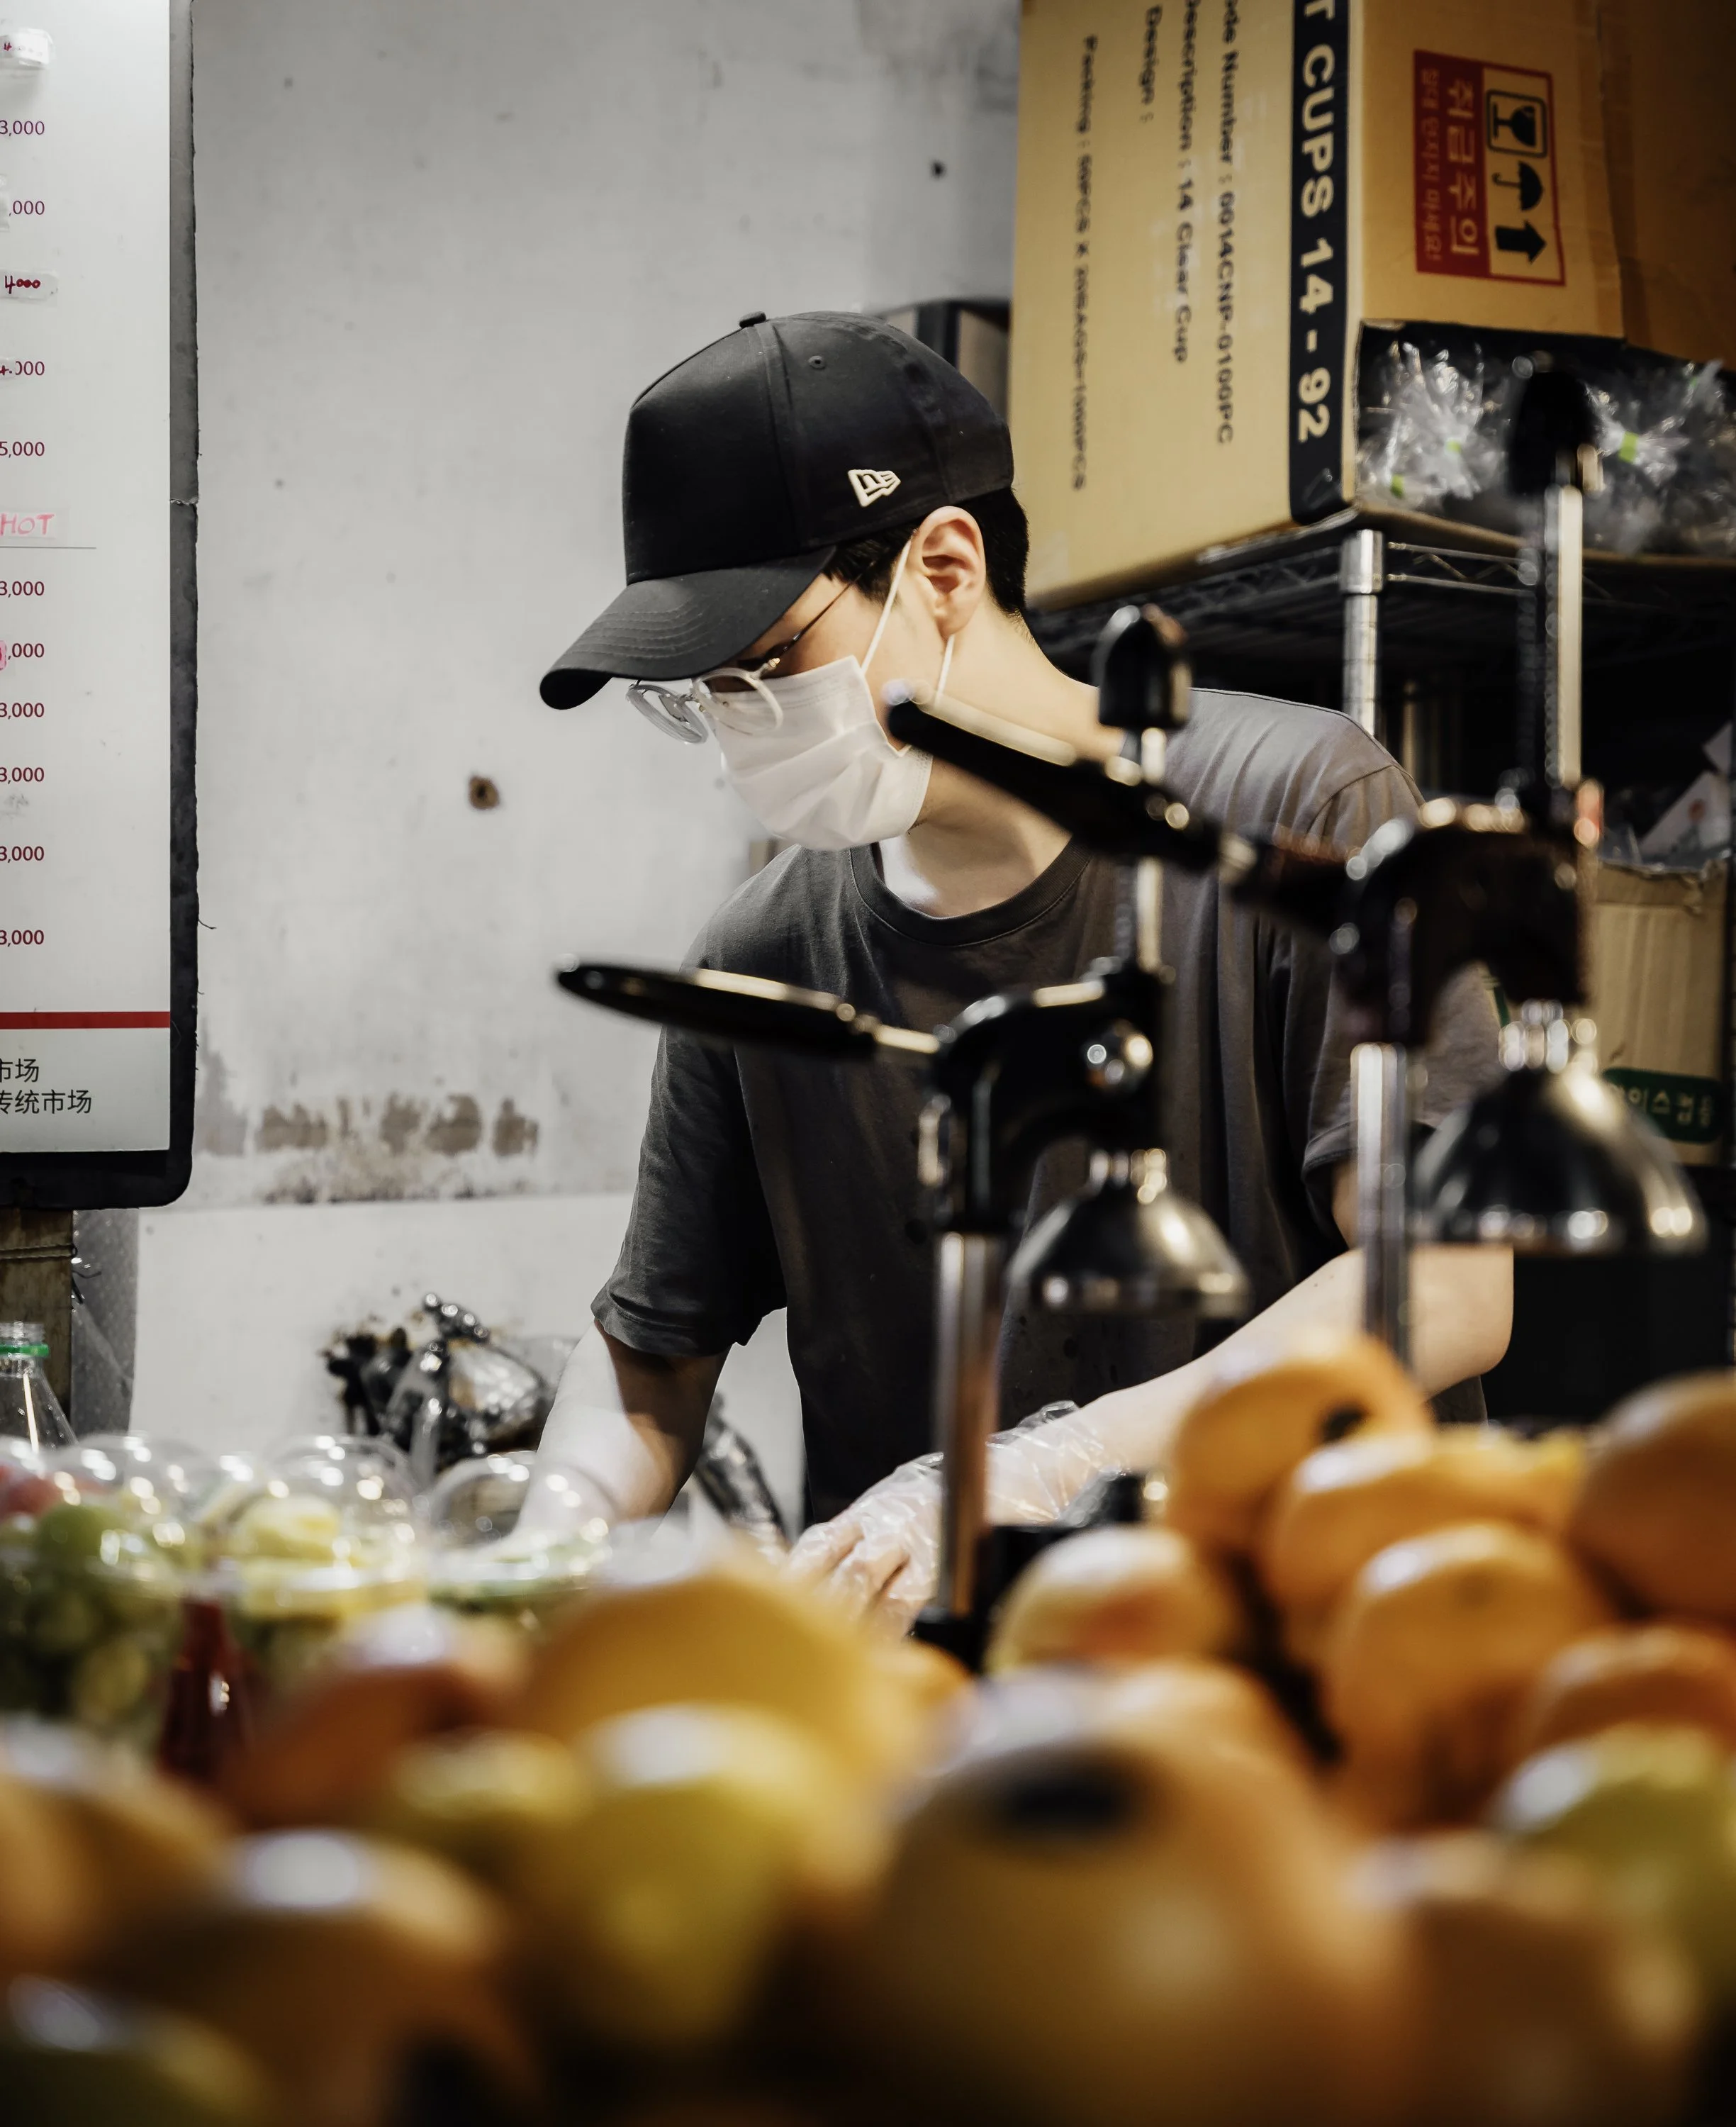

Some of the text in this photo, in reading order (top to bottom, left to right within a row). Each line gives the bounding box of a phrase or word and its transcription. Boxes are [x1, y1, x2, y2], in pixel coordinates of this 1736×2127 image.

[1139, 6, 1163, 105] Design
[0, 119, 45, 137] 3,000
[1219, 49, 1241, 164] Number
[1301, 44, 1334, 218] CUPS
[1177, 178, 1194, 211] 14
[1447, 79, 1479, 256] 취급주의
[5, 275, 41, 294] 4000
[1175, 221, 1194, 296] Clear
[1299, 237, 1333, 314] 14
[1172, 303, 1192, 364] Cup
[1306, 329, 1317, 353] -
[1298, 367, 1331, 443] 92
[0, 441, 45, 458] 5,000
[0, 513, 55, 536] HOT
[0, 642, 45, 660] ,000
